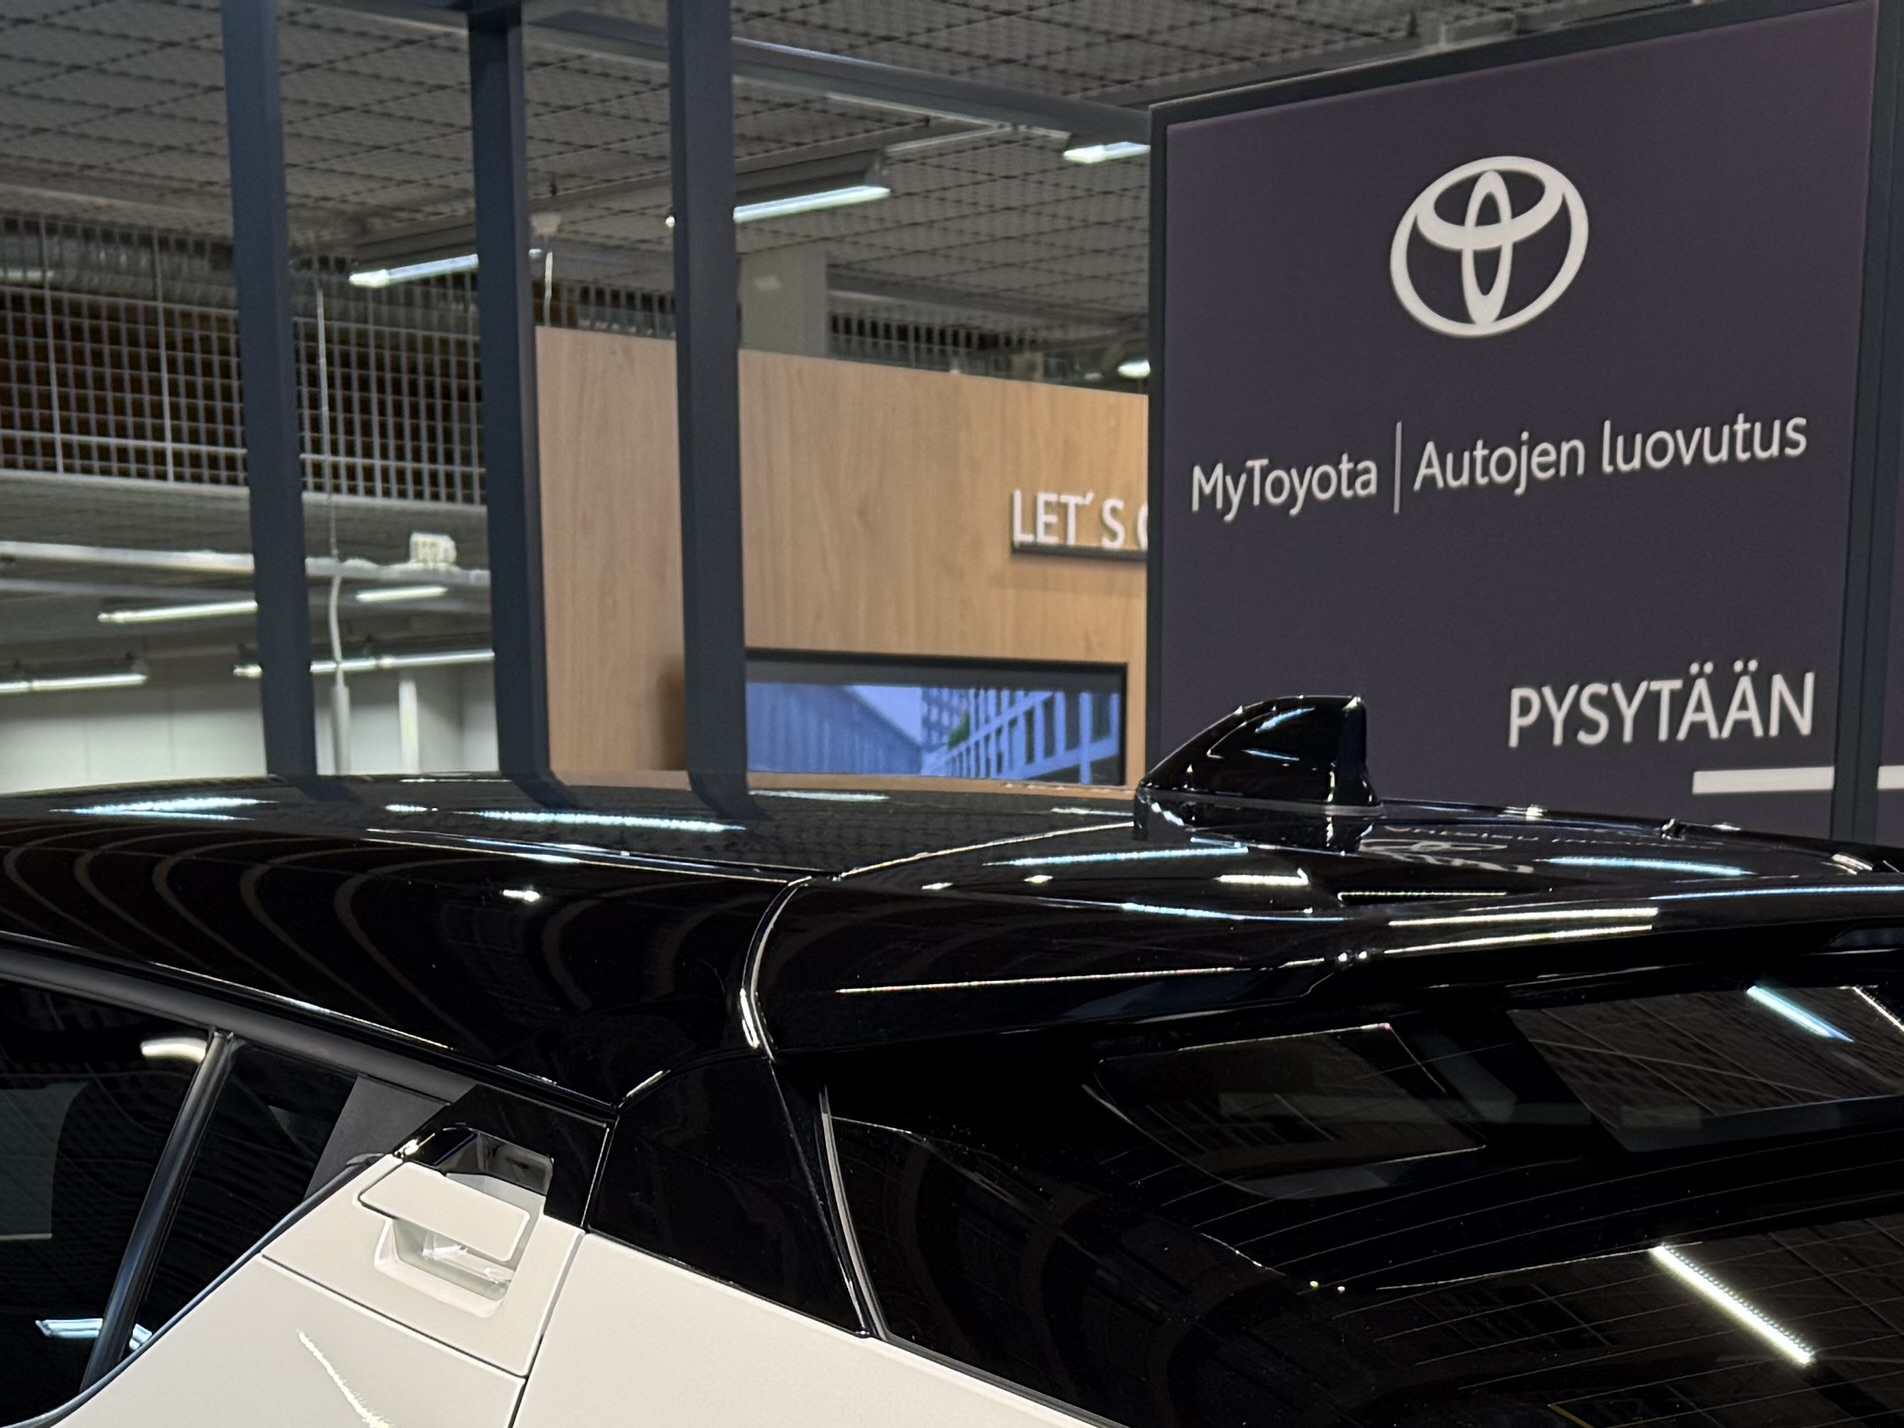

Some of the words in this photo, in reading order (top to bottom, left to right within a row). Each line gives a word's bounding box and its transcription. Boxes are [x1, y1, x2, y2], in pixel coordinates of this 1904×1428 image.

[1192, 460, 1379, 522] MyToyota
[1413, 432, 1585, 496] Autojen
[1601, 412, 1809, 474] luovutus
[1508, 658, 1816, 748] PYSYTÄÄN
